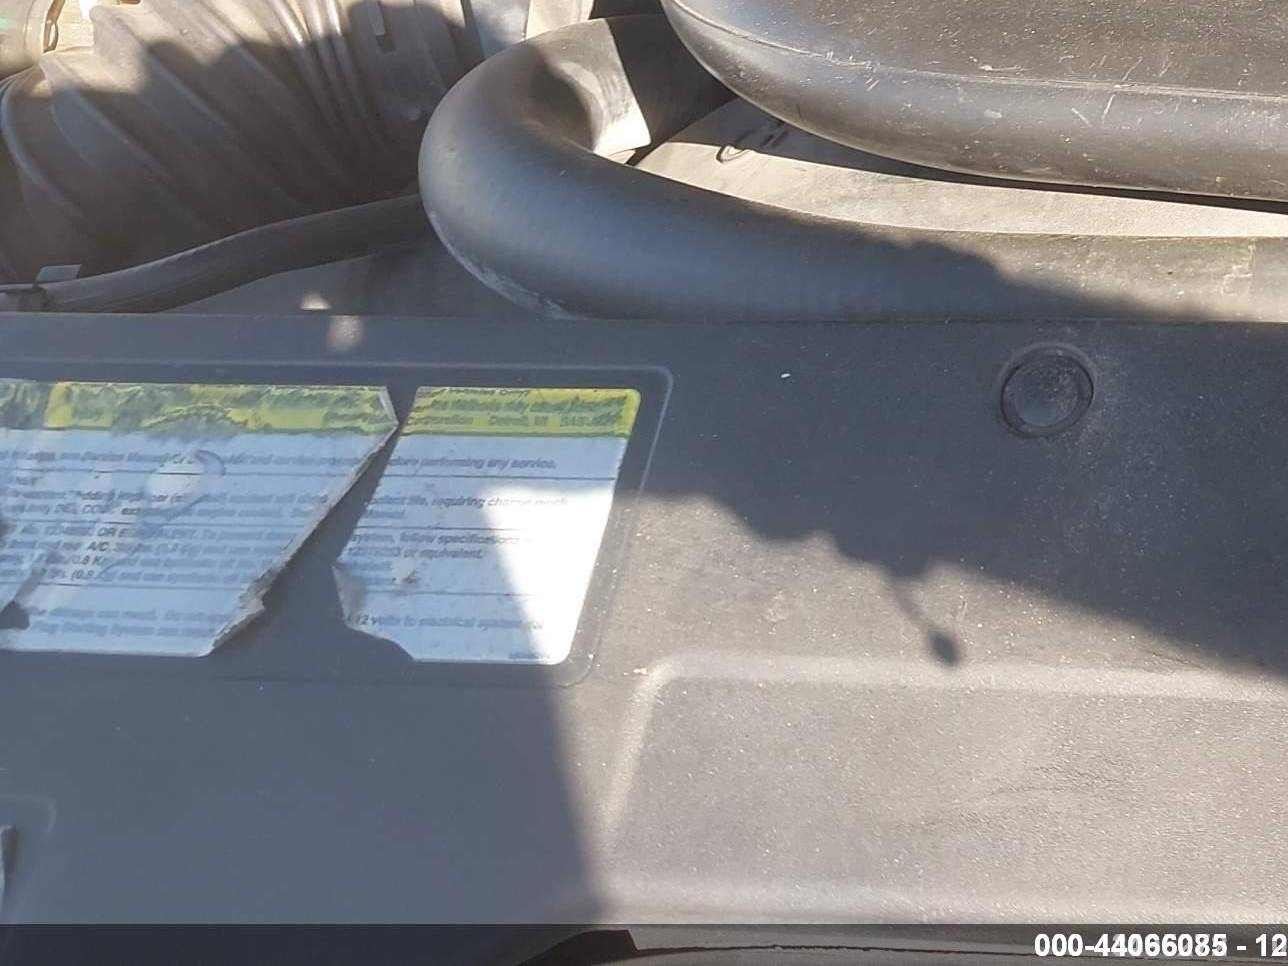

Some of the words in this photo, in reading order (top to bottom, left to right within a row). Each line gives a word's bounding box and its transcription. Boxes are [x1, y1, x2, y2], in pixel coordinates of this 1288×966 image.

[420, 458, 484, 469] performing
[487, 458, 509, 470] any
[431, 496, 486, 509] requiring
